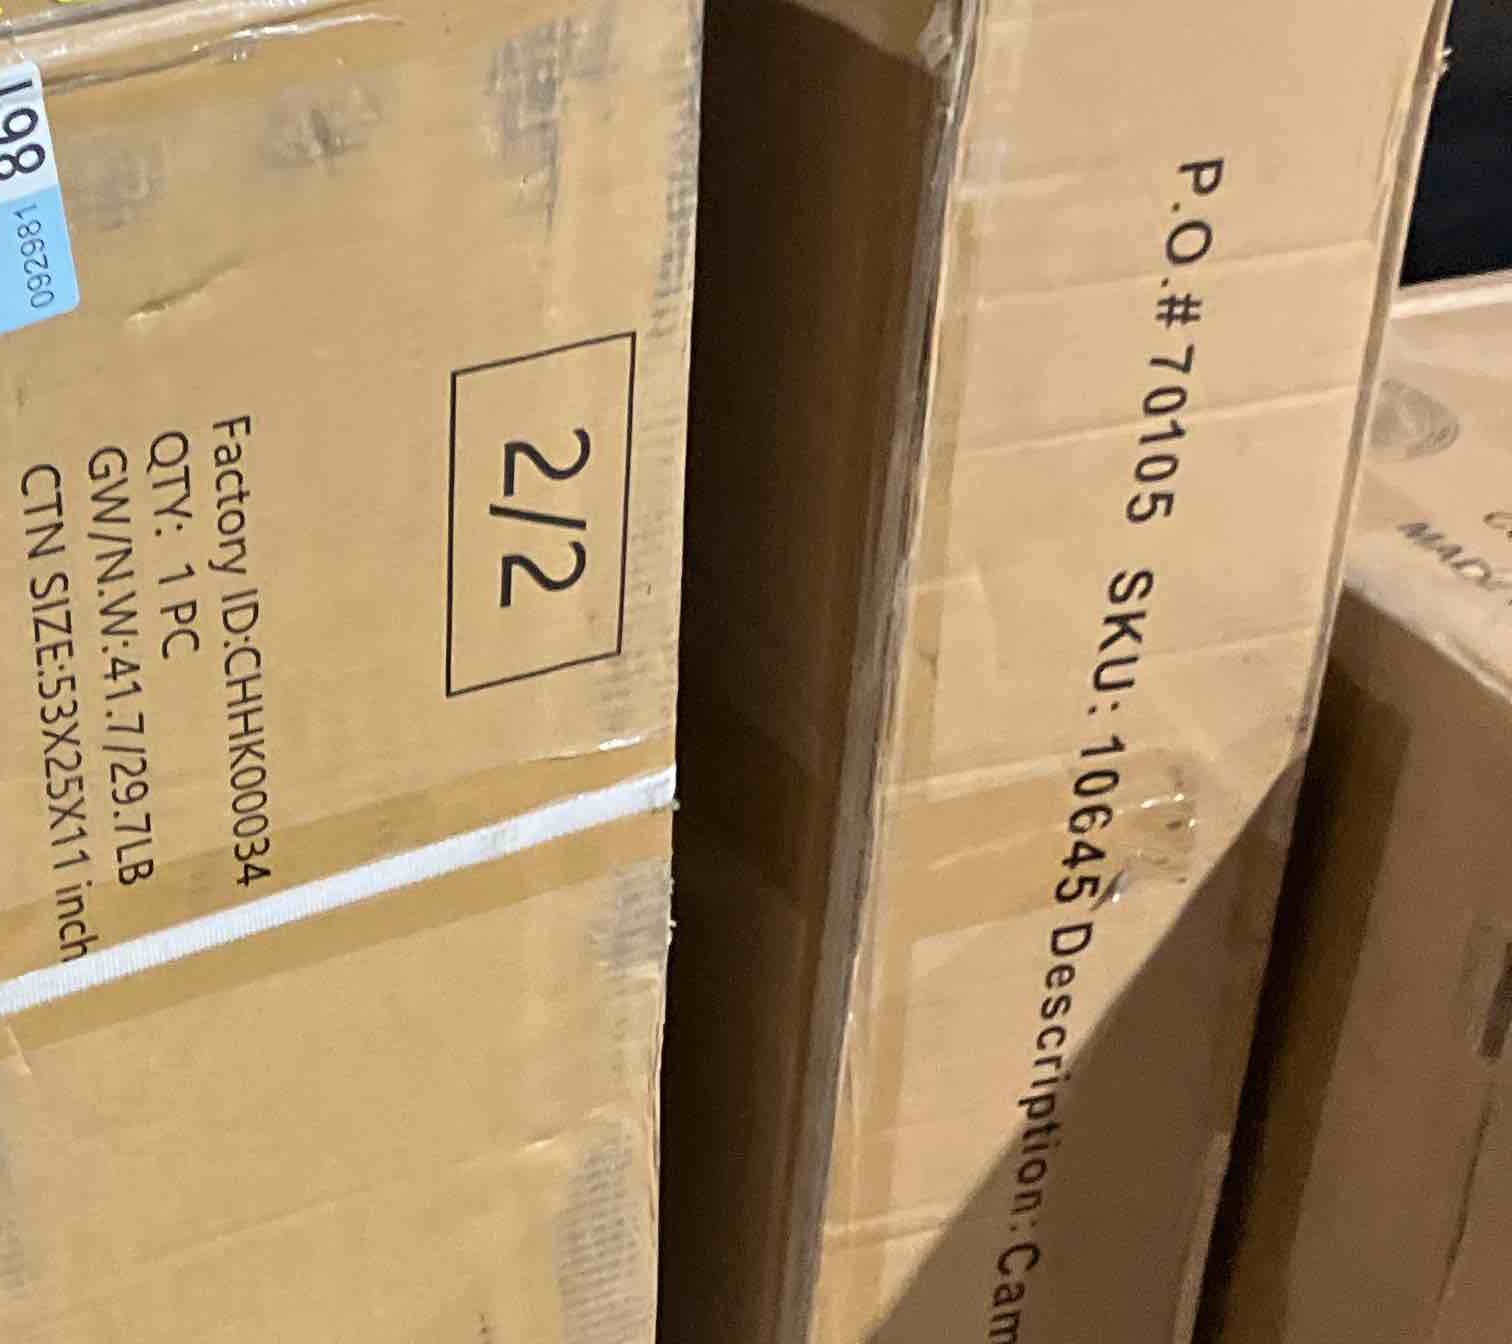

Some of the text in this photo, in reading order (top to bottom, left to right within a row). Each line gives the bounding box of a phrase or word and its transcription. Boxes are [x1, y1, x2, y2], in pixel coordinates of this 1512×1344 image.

[13, 203, 56, 310] 092981
[86, 444, 155, 887] GW/N.W:41.7/29.7LB
[146, 430, 201, 660] QTY: 1 PC
[207, 415, 272, 888] Factory ID:CHHK00034
[488, 426, 592, 610] 2/2
[20, 462, 100, 962] CTN SIZE:53X25X11 inch
